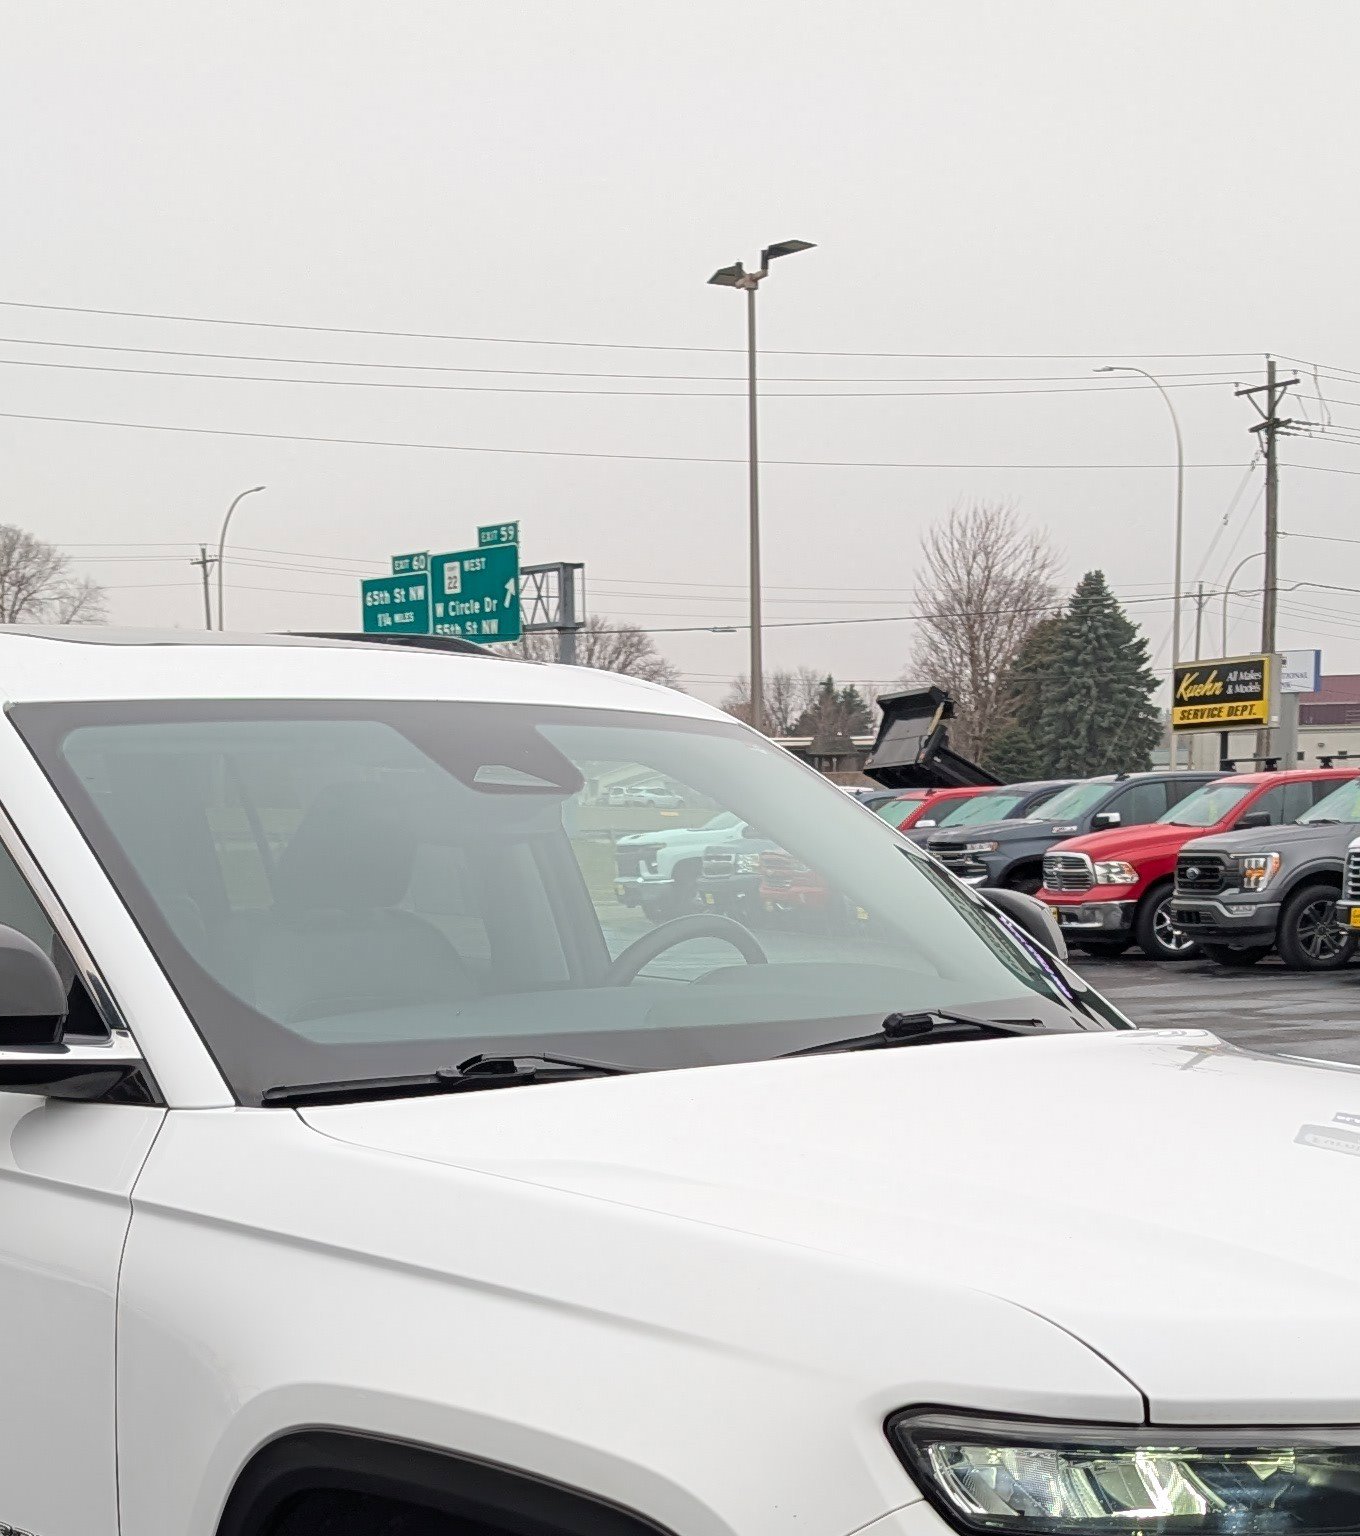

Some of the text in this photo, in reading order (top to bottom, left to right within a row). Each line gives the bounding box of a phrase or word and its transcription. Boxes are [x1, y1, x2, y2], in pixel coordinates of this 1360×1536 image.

[500, 525, 515, 541] 59
[394, 555, 426, 570] EXIT 60
[463, 557, 486, 572] WEST
[447, 575, 458, 590] 22
[365, 585, 425, 606] 65th St NW
[435, 596, 498, 618] W Circle Dr
[435, 618, 499, 635] 55th St NW
[1176, 669, 1223, 701] Kuehn
[1180, 703, 1257, 720] SERVICE DEPT.
